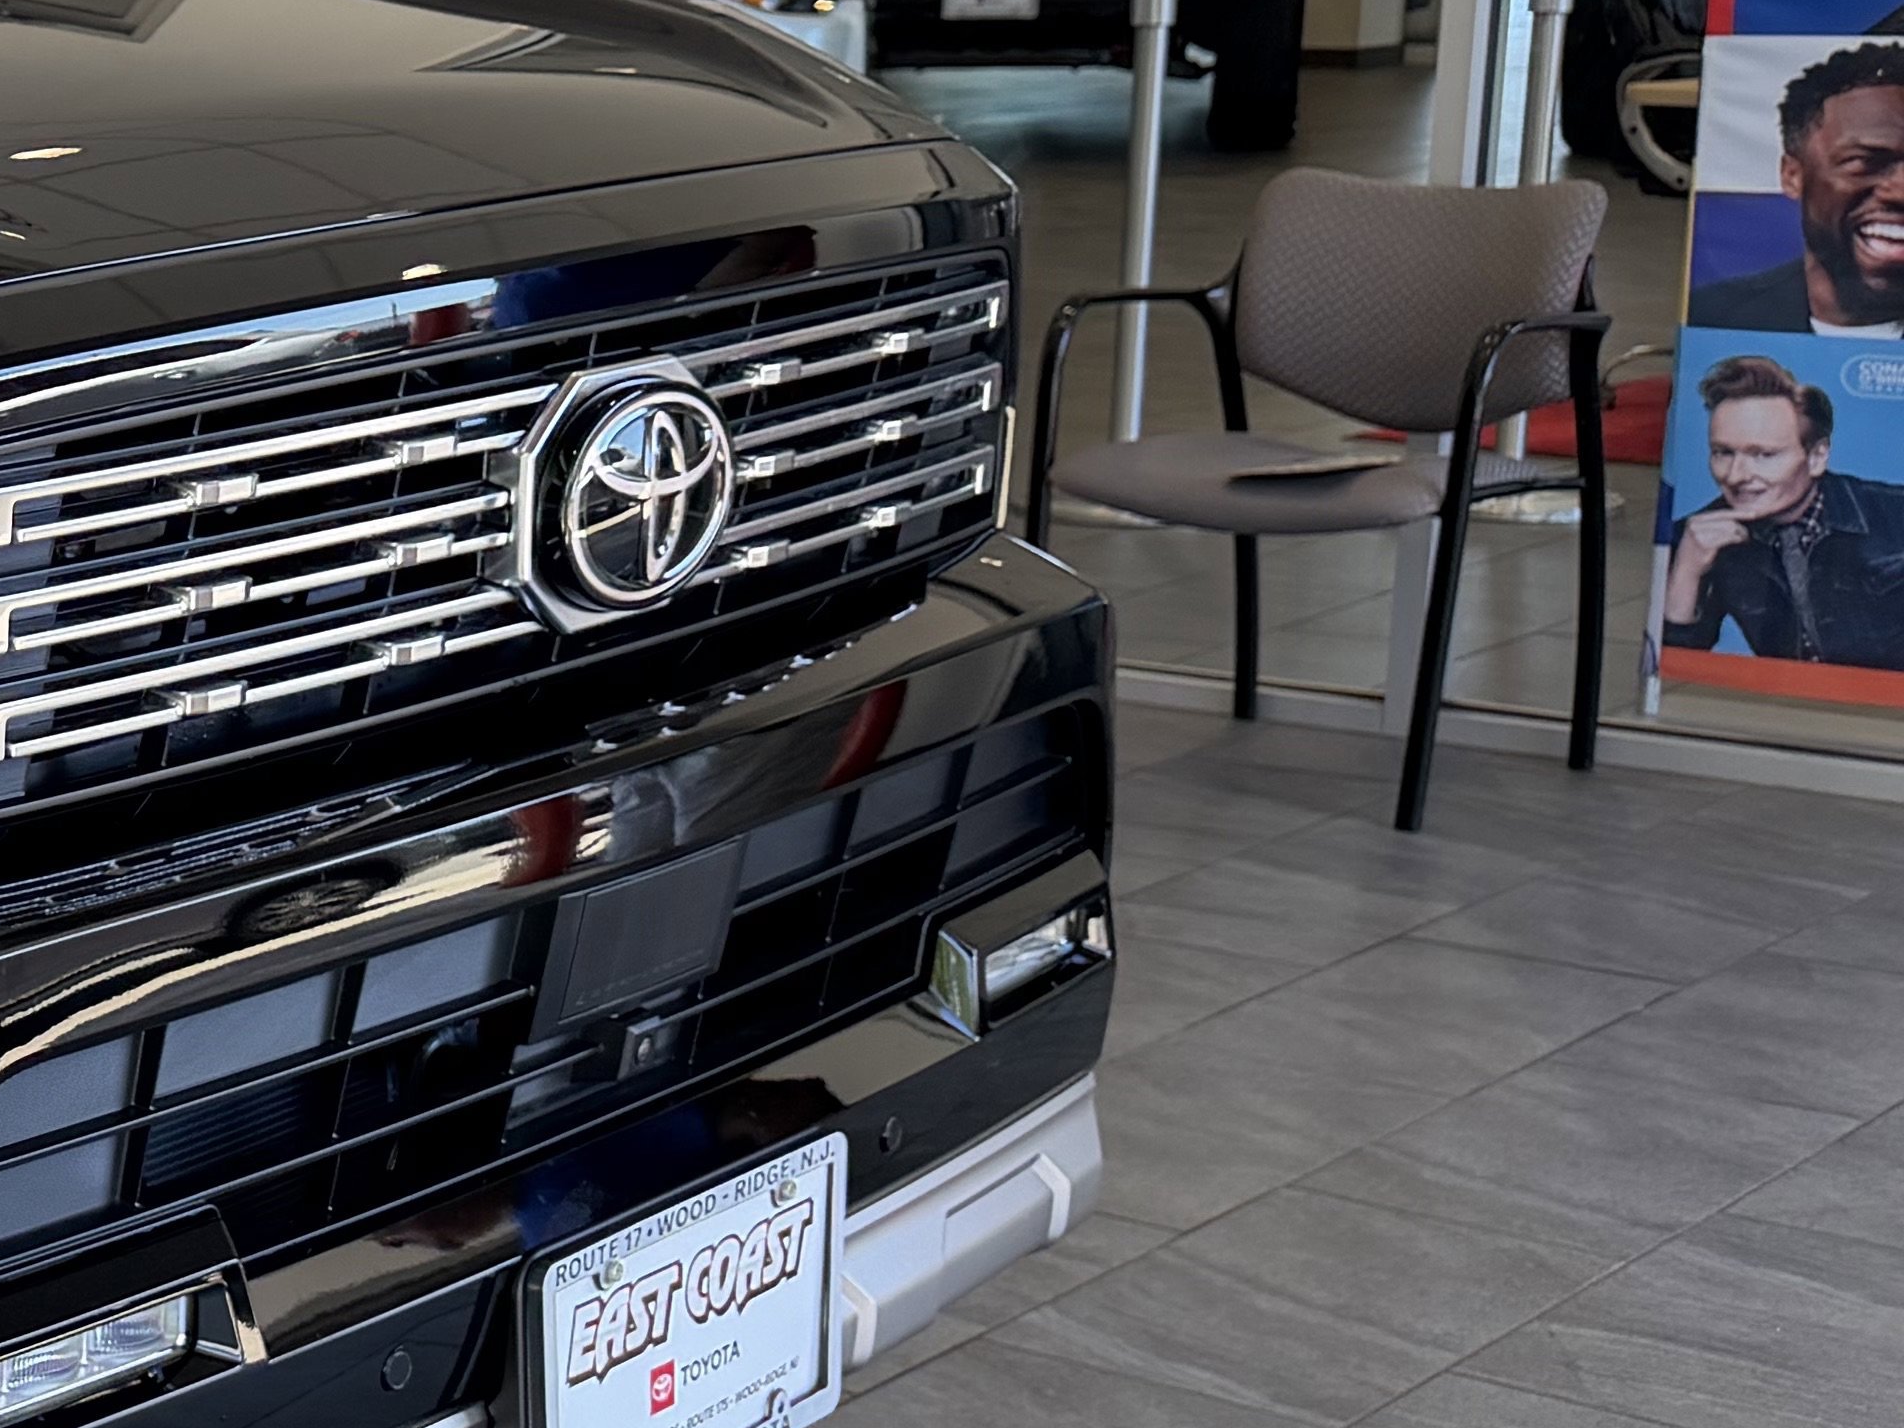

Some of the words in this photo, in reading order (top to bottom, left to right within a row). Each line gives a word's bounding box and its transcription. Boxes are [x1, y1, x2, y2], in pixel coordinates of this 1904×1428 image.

[555, 1240, 619, 1287] ROUTE
[625, 1227, 643, 1253] 17
[657, 1193, 717, 1237] WOOD
[799, 1140, 835, 1171] N.J.
[566, 1260, 683, 1387] EAST
[685, 1196, 814, 1324] COAST
[680, 1340, 741, 1386] TOYOTA
